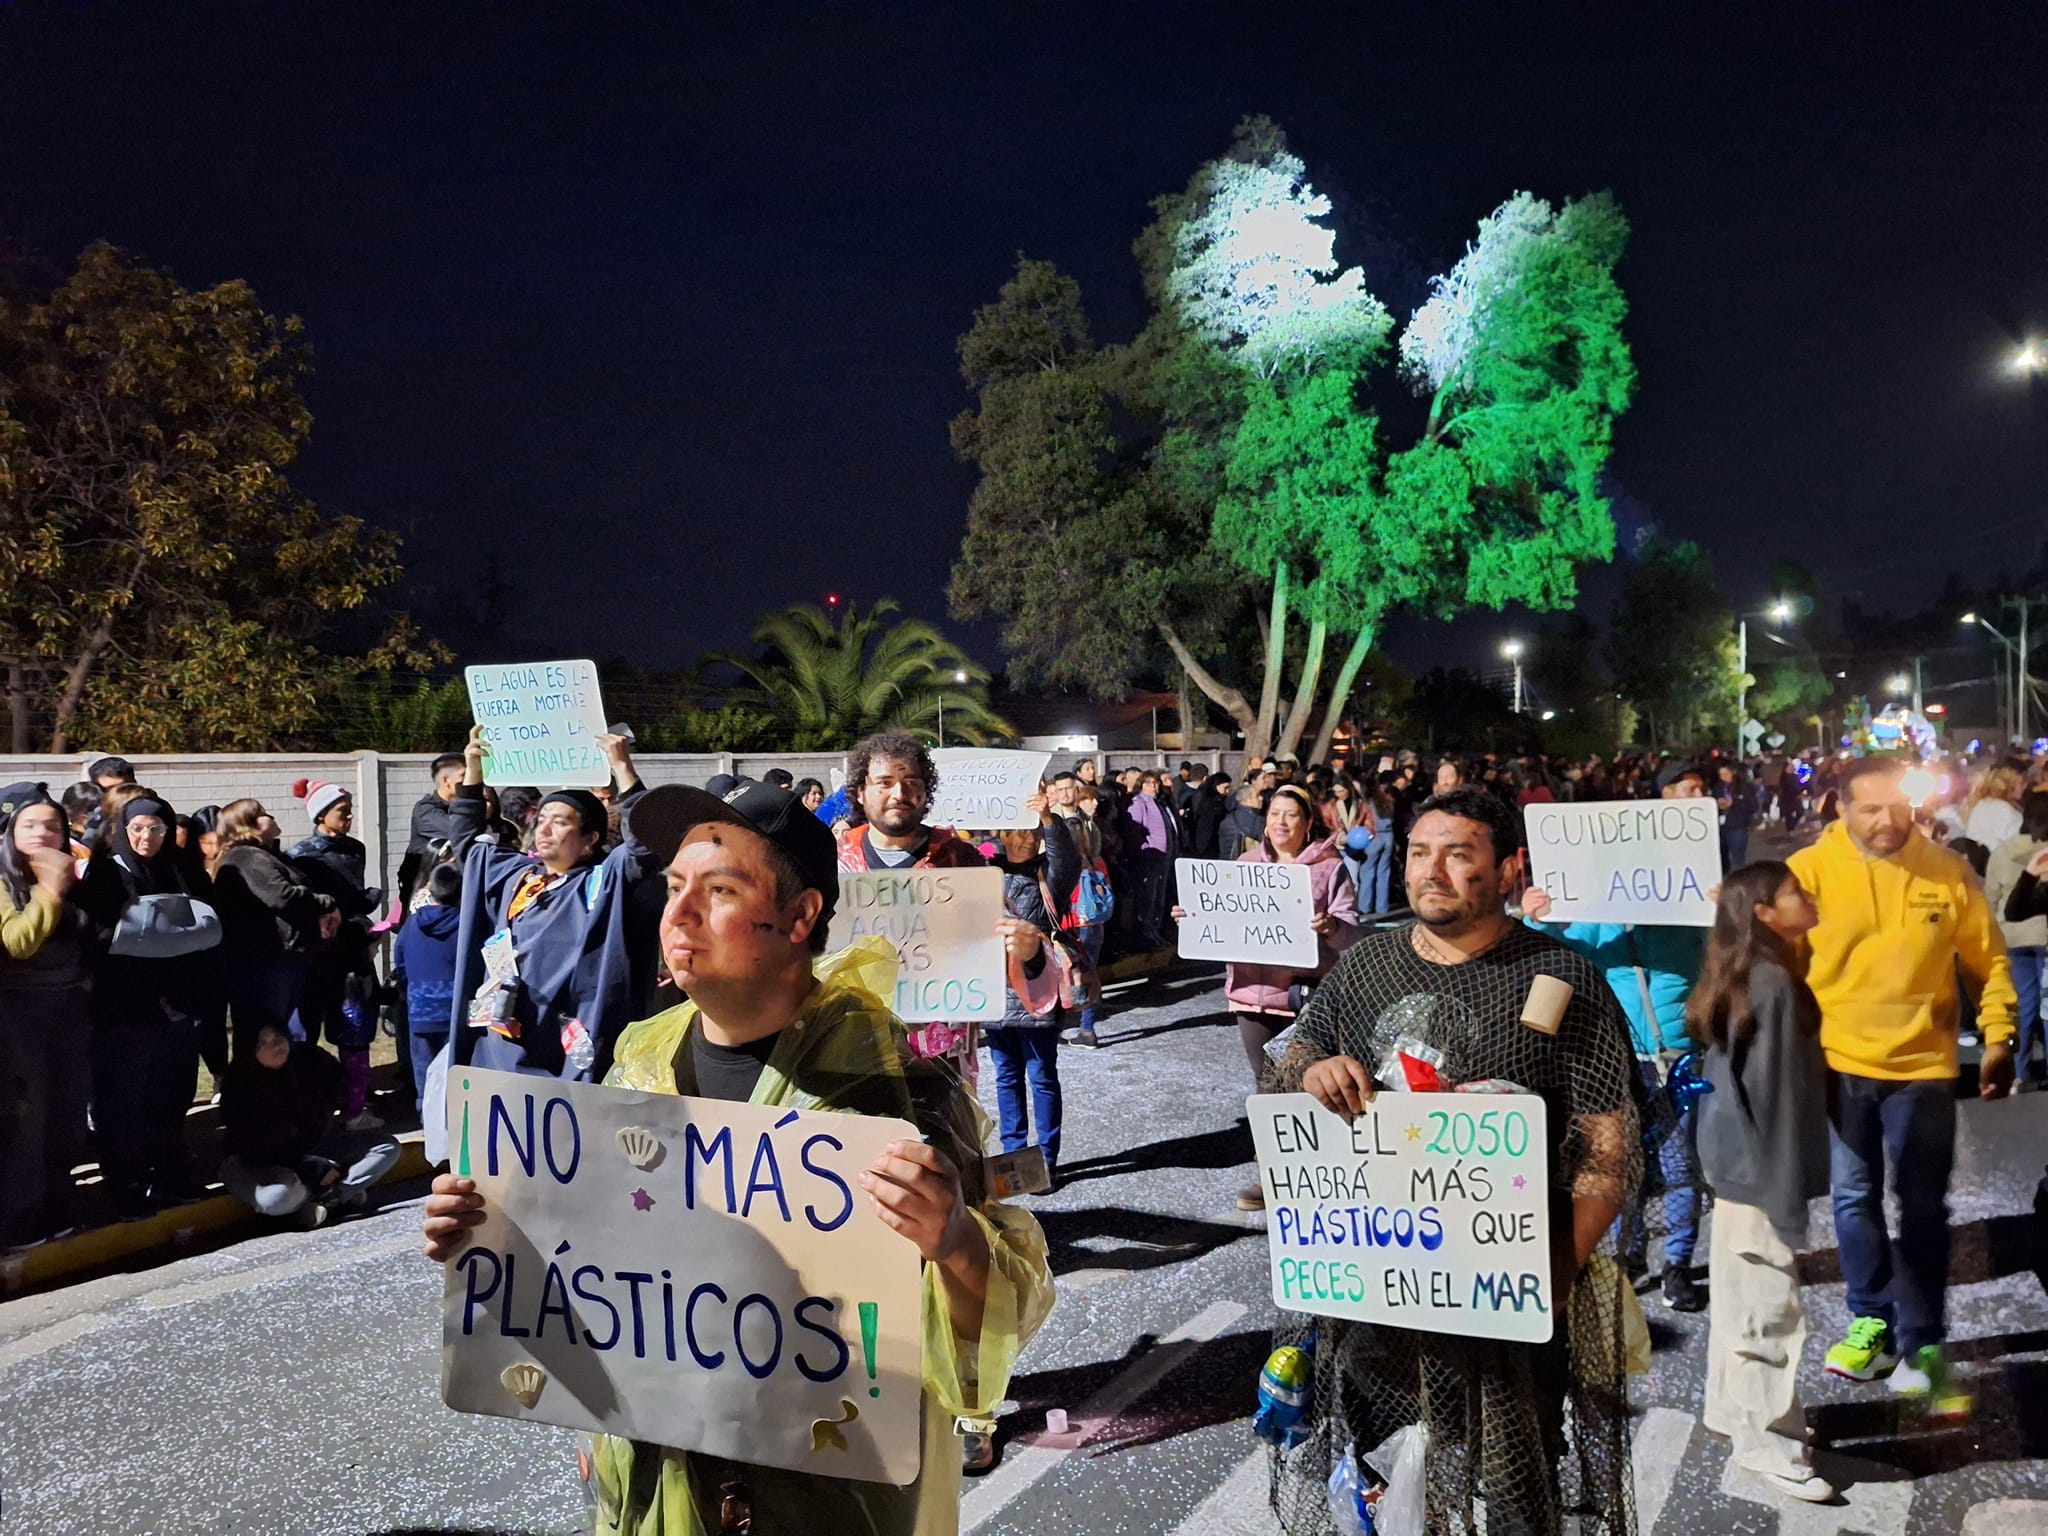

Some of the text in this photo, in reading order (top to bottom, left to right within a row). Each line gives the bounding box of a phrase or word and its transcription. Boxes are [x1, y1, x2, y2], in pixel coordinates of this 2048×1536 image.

[473, 674, 493, 694] EL
[500, 668, 539, 691] AGUA
[546, 667, 566, 688] ES
[475, 699, 521, 718] FUERZA
[486, 720, 588, 741] DE TODA LA
[491, 744, 604, 775] NATURALEZA
[940, 773, 1008, 785] UESTROS
[1540, 806, 1708, 846] CUIDEMOS
[843, 874, 955, 909] IDEMOS
[1192, 862, 1291, 890] NO TIRES
[1545, 866, 1705, 903] EL AGUA
[1199, 891, 1280, 913] BASURA
[1200, 924, 1293, 945] AL MAR
[895, 978, 989, 1013] TICOS
[1273, 1110, 1529, 1157] EN EL 2050
[685, 1110, 854, 1232] MÁS
[1269, 1159, 1493, 1202] HABRÁ MÁS
[1472, 1211, 1536, 1245] QUE
[1279, 1257, 1548, 1313] PECES EN EL MAR
